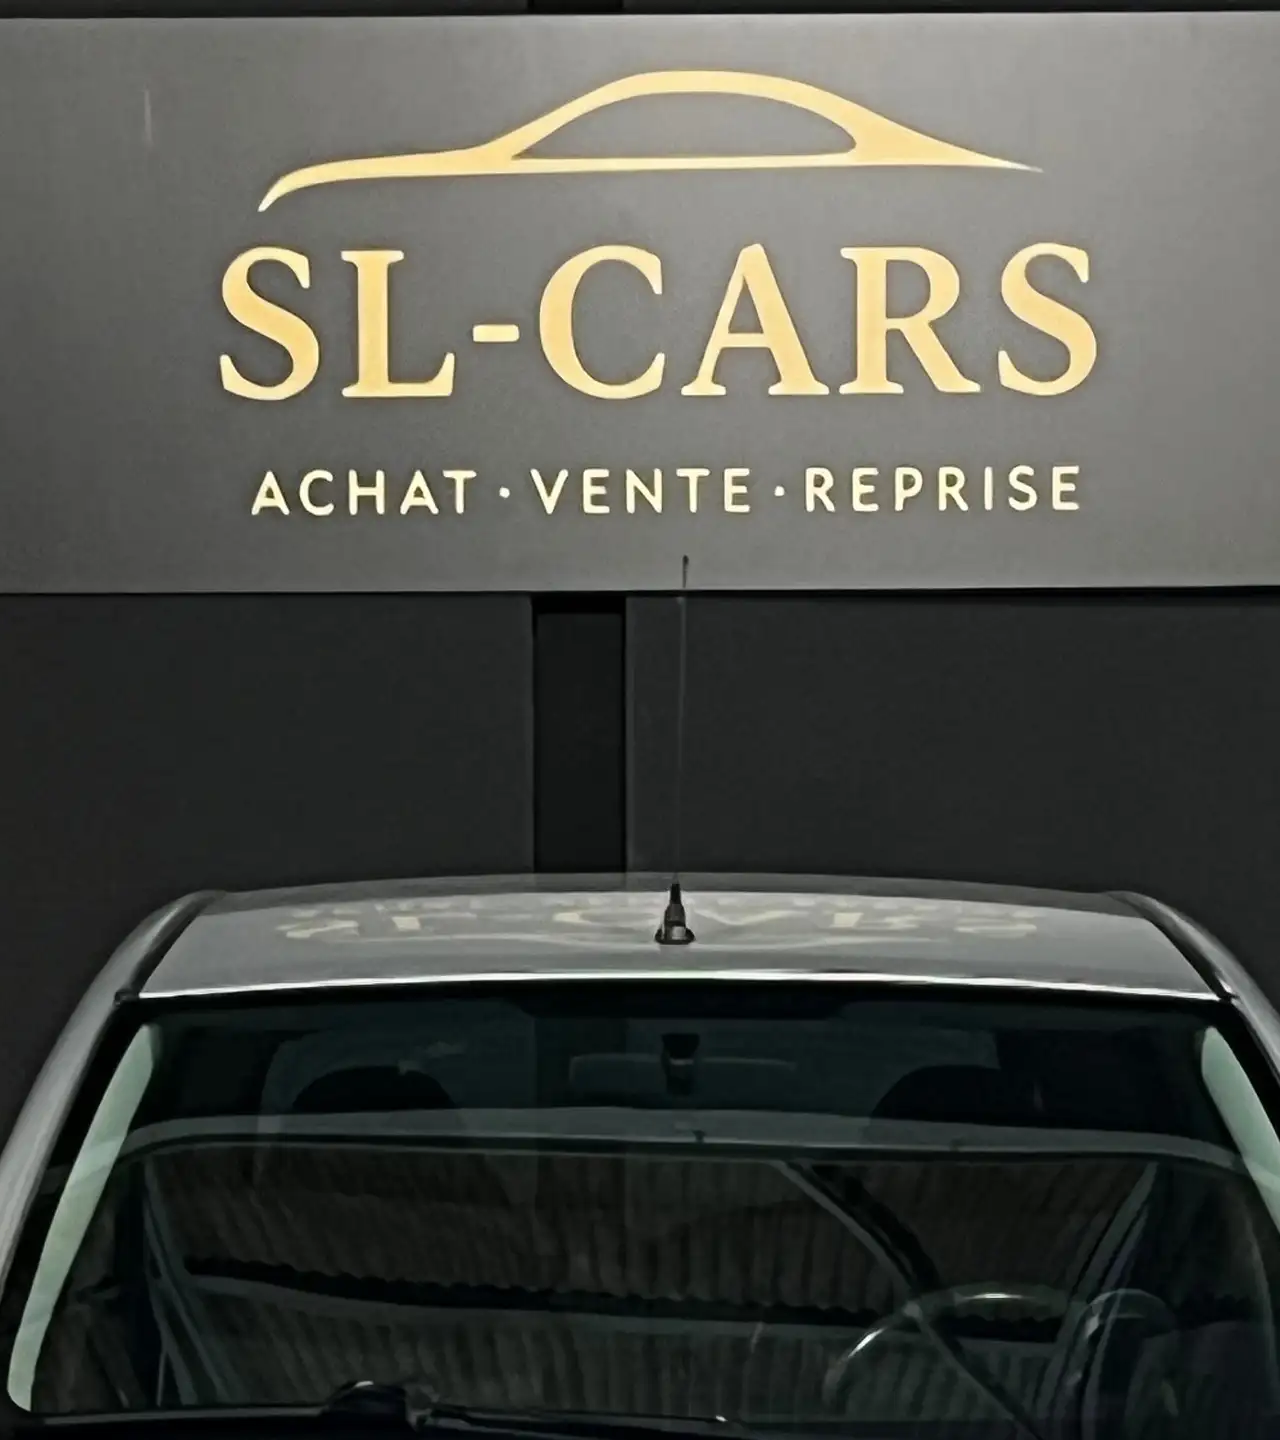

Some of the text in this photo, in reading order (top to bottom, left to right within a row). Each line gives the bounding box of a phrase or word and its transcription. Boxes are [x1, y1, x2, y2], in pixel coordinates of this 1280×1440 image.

[218, 241, 1098, 401] SL-CARS
[250, 464, 1081, 516] ACHAT VENTE REPRISE
